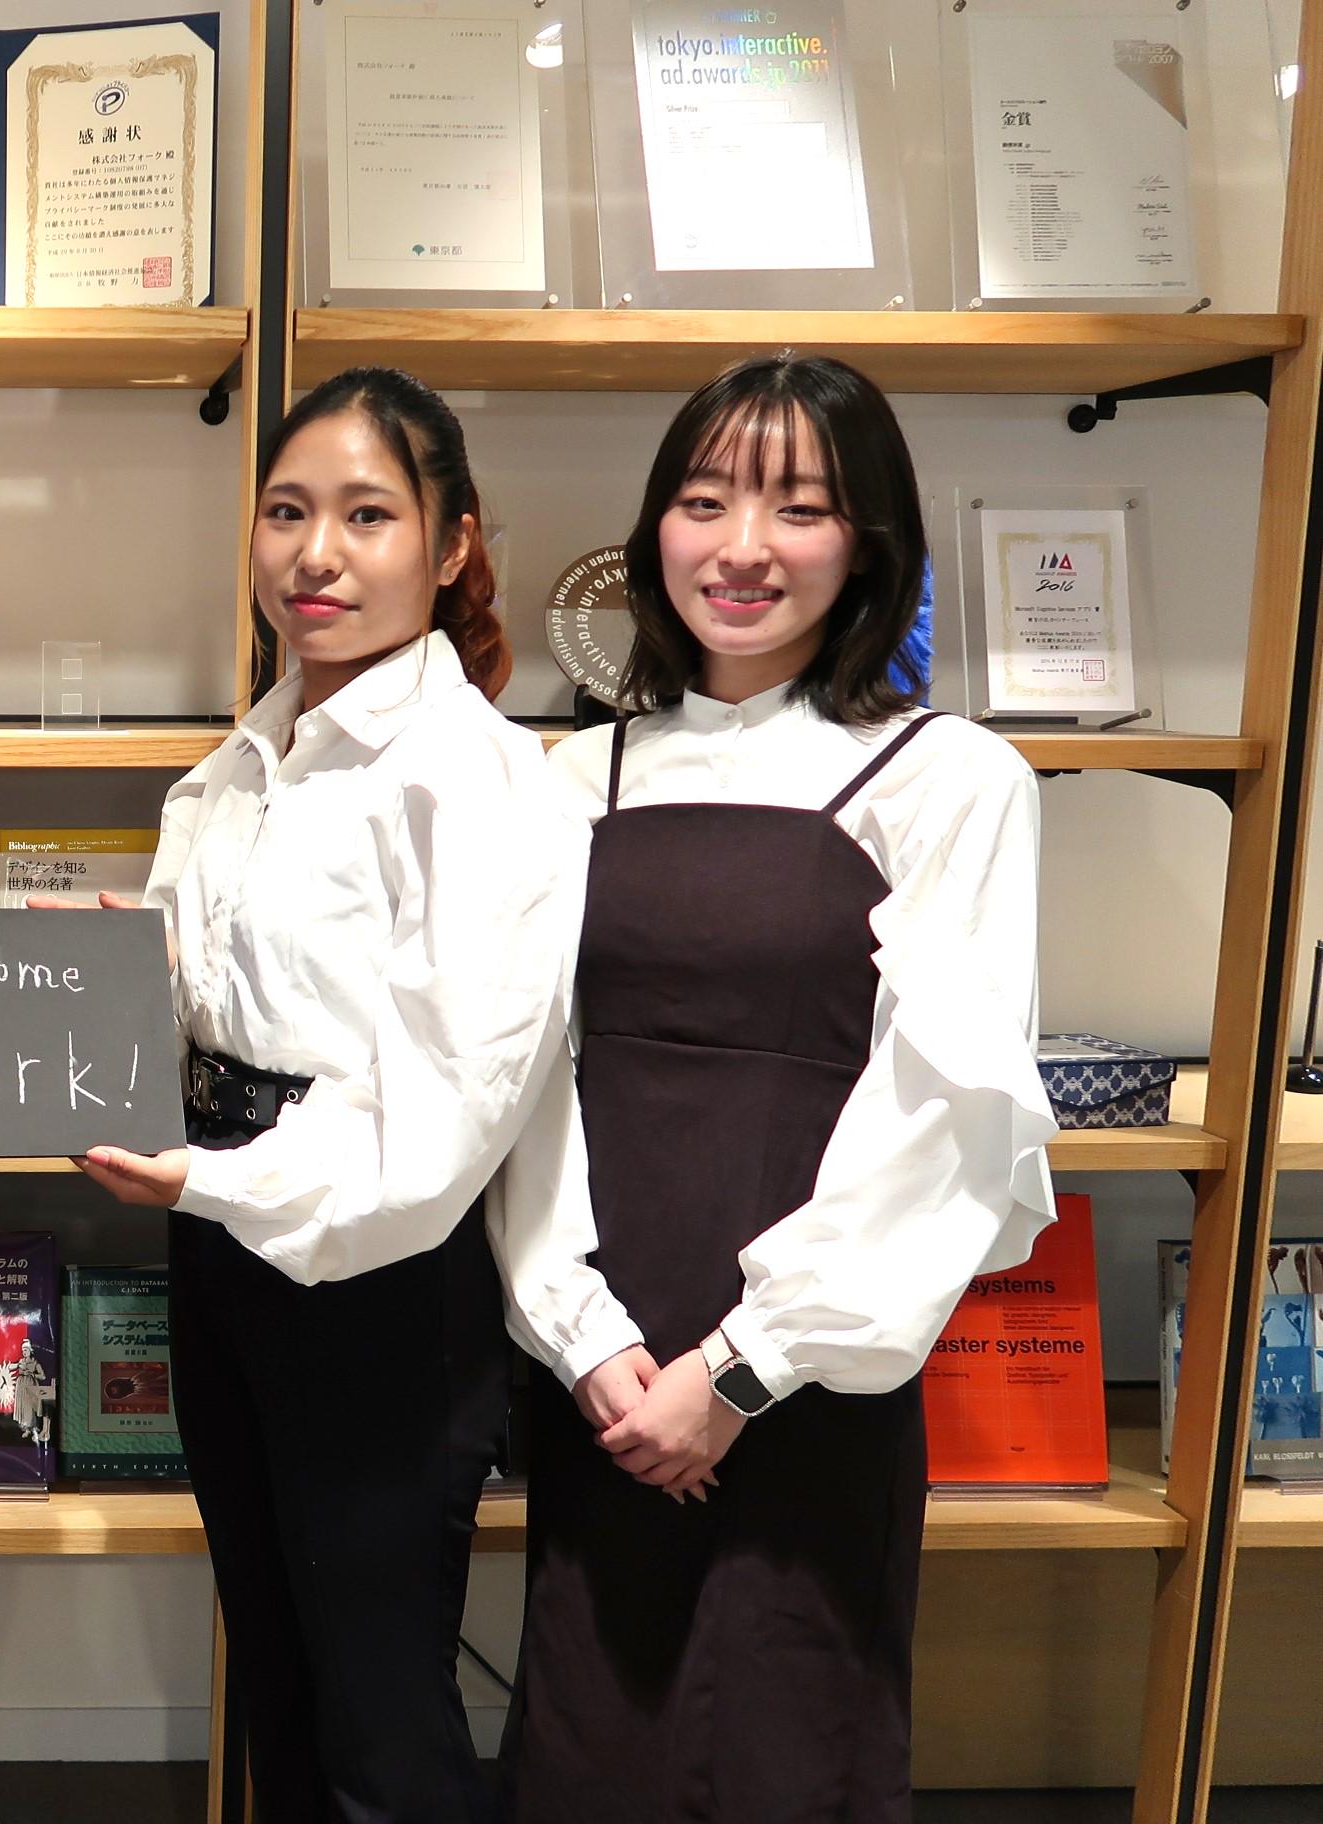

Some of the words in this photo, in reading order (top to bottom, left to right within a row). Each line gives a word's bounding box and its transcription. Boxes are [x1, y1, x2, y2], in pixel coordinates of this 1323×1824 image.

[1001, 112, 1032, 126] 金賞
[78, 124, 142, 145] 感謝状
[588, 549, 625, 568] Japan
[553, 563, 591, 607] internet
[1035, 579, 1076, 593] 2016
[551, 608, 586, 679] advertising
[8, 841, 61, 852] Bibliographic
[8, 860, 87, 874] デザインを知る
[7, 877, 74, 891] 世界の名著
[967, 1276, 1056, 1297] systems
[2, 1291, 28, 1301] 第二版
[102, 1319, 169, 1332] データベース
[931, 1336, 990, 1354] aster
[996, 1336, 1085, 1358] systeme
